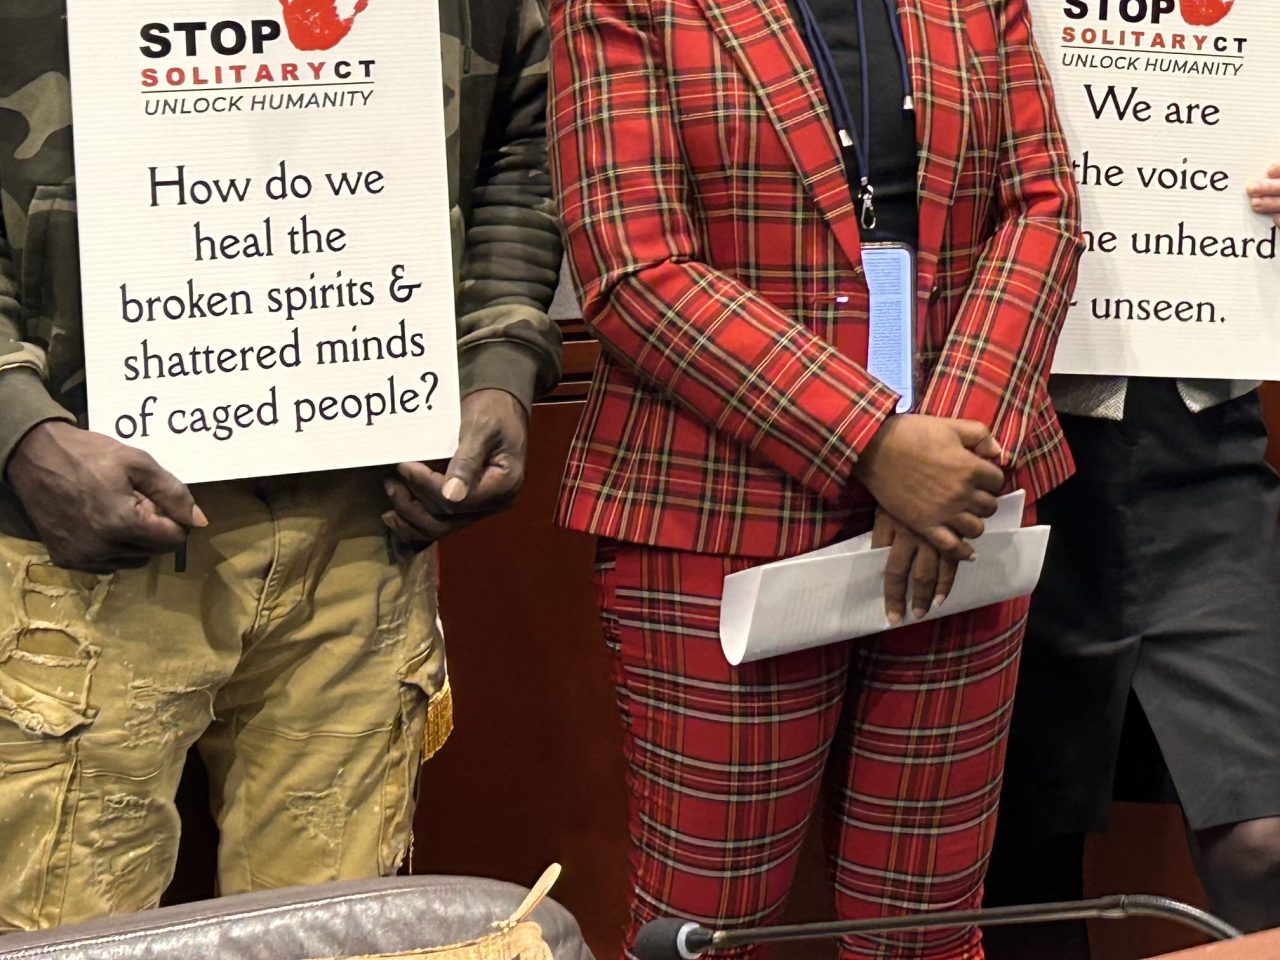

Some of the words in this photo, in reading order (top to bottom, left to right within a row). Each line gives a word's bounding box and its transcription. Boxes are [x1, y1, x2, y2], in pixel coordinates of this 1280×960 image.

[140, 20, 281, 58] STOP
[1062, 53, 1141, 71] UNLOCK
[1144, 58, 1244, 76] HUMANITY
[145, 95, 244, 116] UNLOCK
[250, 90, 374, 111] HUMANITY
[1084, 84, 1152, 122] We
[1165, 103, 1220, 126] are
[149, 166, 252, 207] How
[266, 160, 313, 201] do
[325, 171, 385, 196] we
[1137, 158, 1229, 192] voice
[194, 217, 274, 262] heal
[288, 215, 347, 255] the
[1132, 221, 1277, 259] unheard
[120, 279, 253, 323] broken
[267, 271, 375, 321] spirits
[390, 265, 422, 303] &
[1091, 298, 1226, 324] unseen.
[124, 327, 303, 381] shattered
[316, 319, 425, 365] minds
[115, 395, 158, 439] of
[167, 386, 279, 441] caged
[294, 372, 439, 433] people?
